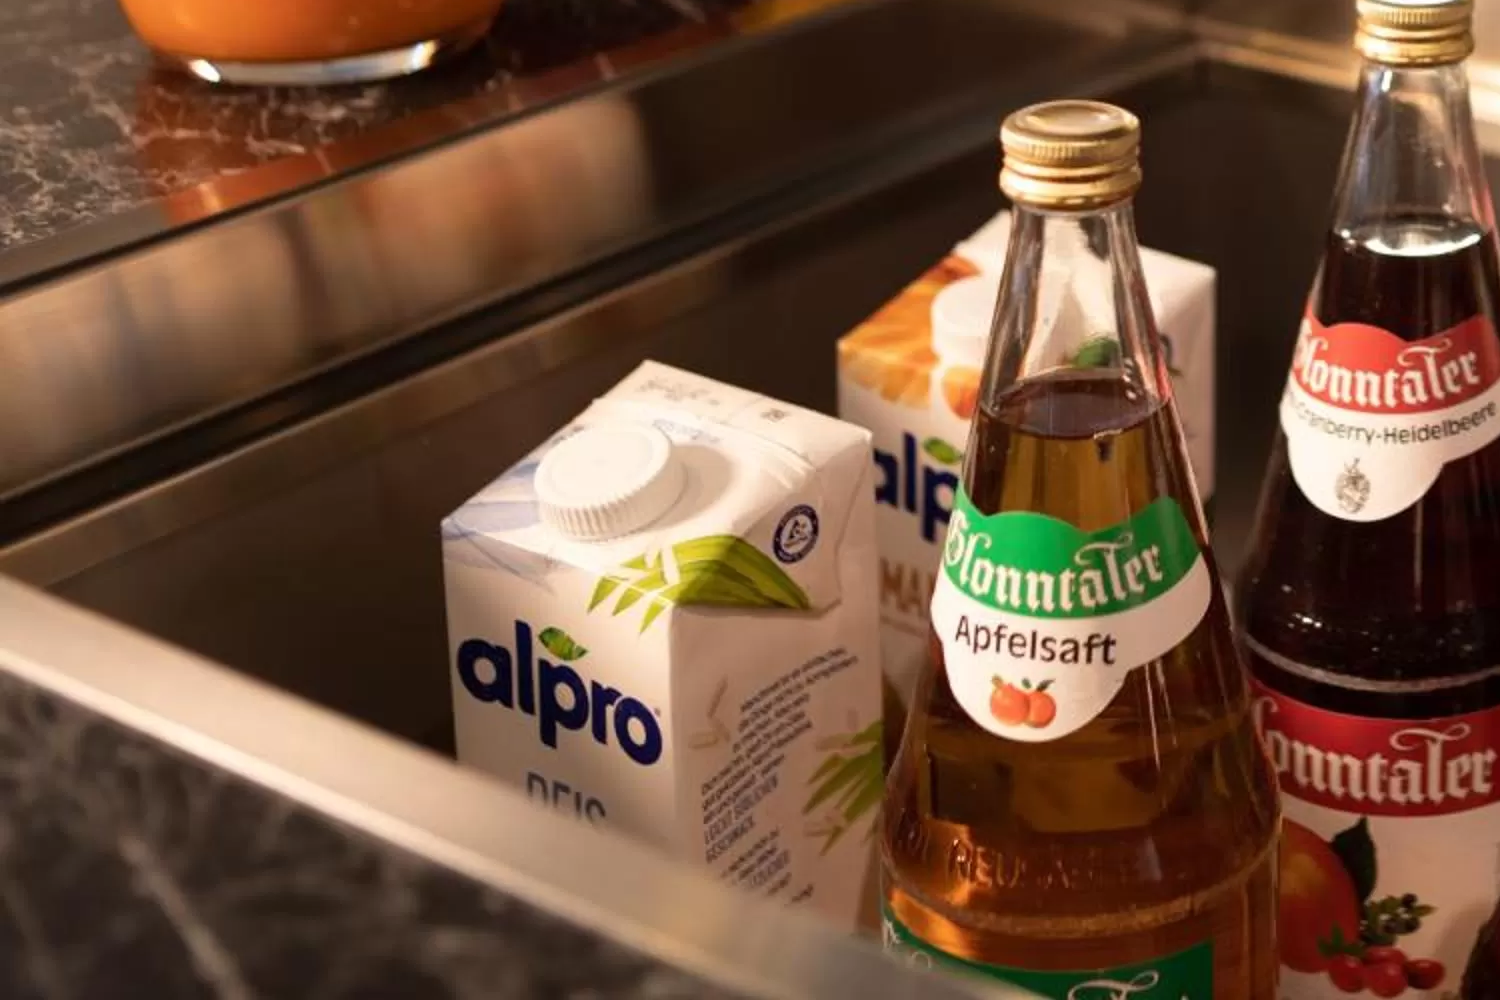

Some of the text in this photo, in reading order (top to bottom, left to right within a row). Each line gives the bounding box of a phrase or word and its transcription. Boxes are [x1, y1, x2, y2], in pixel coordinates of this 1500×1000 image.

[944, 508, 1164, 614] Glonntaler
[457, 619, 664, 767] alpro
[955, 614, 1118, 666] Apfelsaft
